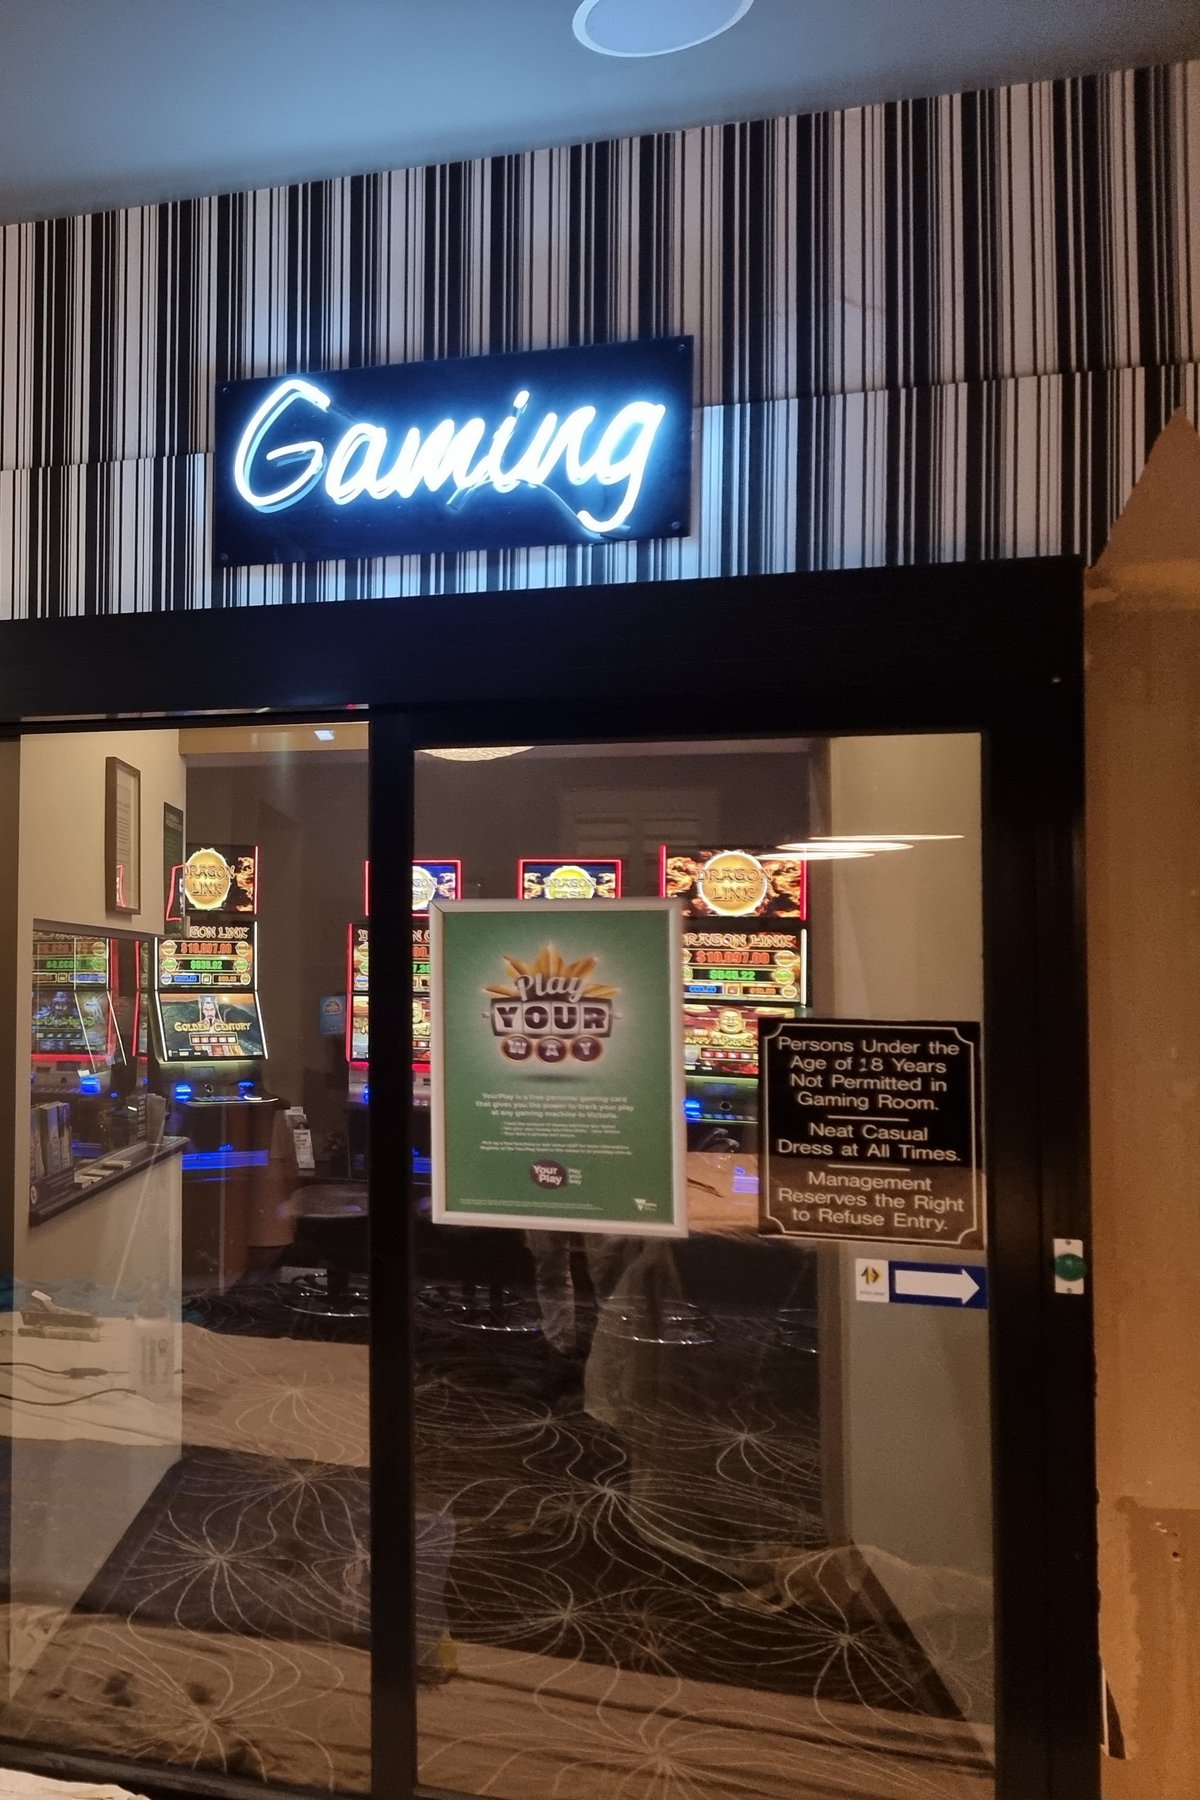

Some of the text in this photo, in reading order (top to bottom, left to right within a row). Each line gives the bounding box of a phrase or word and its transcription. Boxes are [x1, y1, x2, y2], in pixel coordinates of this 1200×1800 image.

[234, 379, 666, 533] Gaming
[696, 868, 774, 882] DRAGON
[192, 882, 226, 897] LINK
[711, 887, 758, 902] LINK
[189, 925, 250, 939] GON LINK
[684, 933, 797, 947] RAGON LINK
[515, 974, 588, 1002] Play
[496, 1006, 607, 1030] YOUR
[507, 1040, 593, 1057] WAY
[777, 1036, 960, 1056] Persons Under the
[790, 1055, 947, 1074] Age of 18 Years
[790, 1073, 947, 1092] Not Permitted in
[797, 1091, 940, 1111] Gaming Room.
[809, 1122, 928, 1141] Neat Casual
[777, 1140, 962, 1161] Dress at All Times.
[532, 1164, 558, 1175] Your
[539, 1174, 563, 1186] Play
[808, 1171, 932, 1192] Management
[778, 1189, 964, 1214] Reserves the Right
[792, 1208, 948, 1232] to Refuse Entry.
